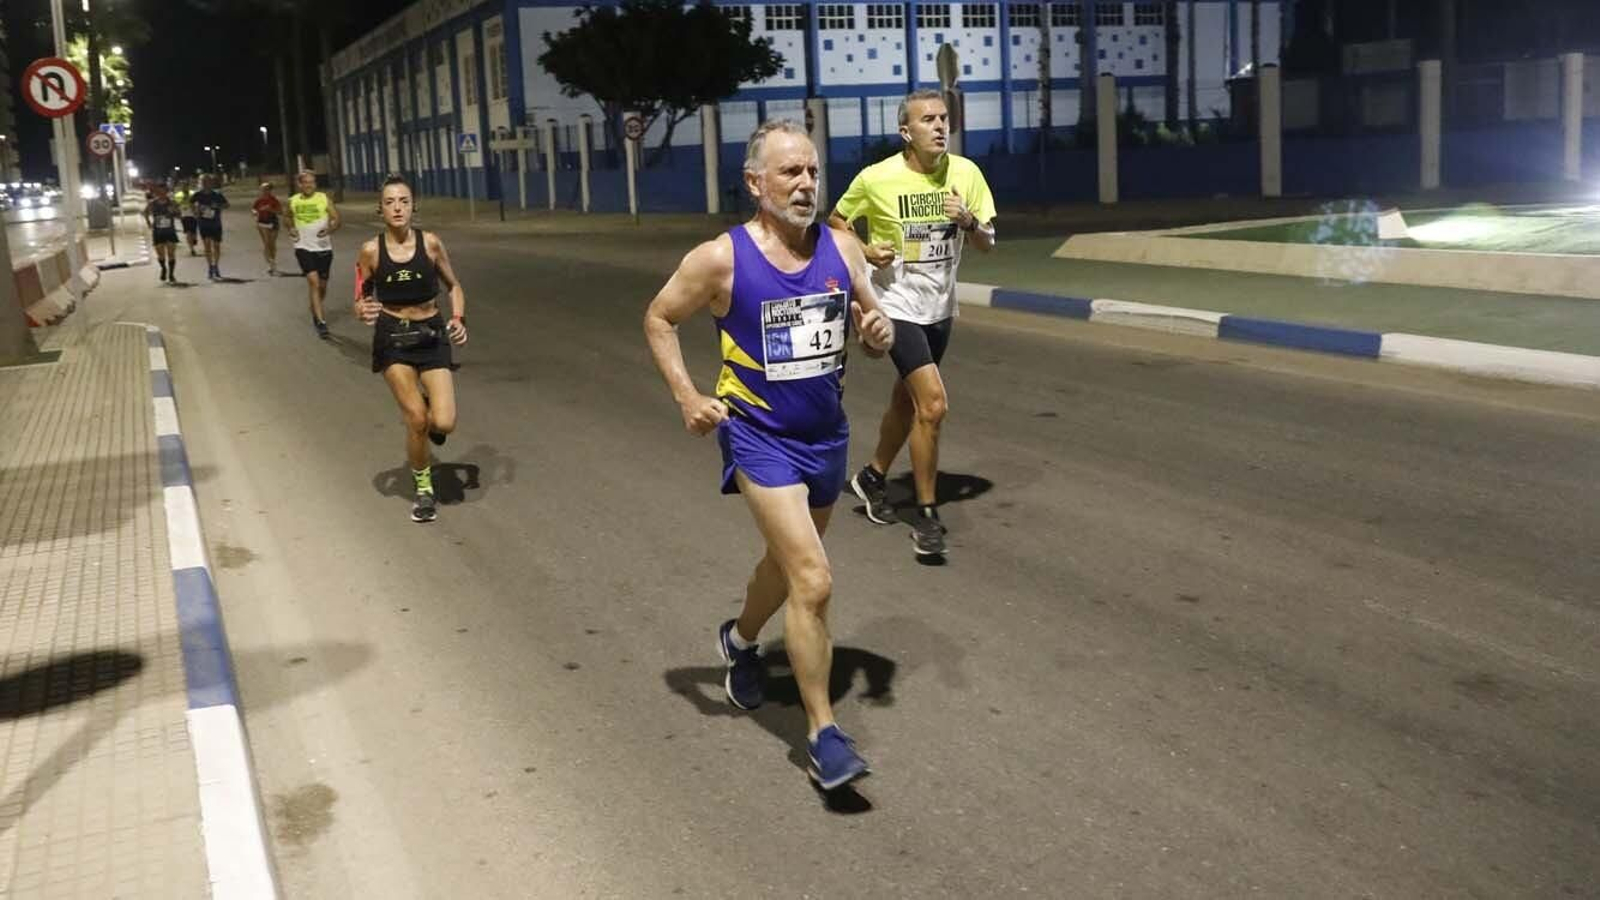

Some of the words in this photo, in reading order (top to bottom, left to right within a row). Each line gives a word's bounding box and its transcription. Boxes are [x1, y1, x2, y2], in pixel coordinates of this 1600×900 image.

[94, 139, 110, 149] 30
[910, 191, 950, 206] CIRCUIT
[898, 194, 909, 219] II
[928, 244, 948, 257] 201
[810, 329, 832, 350] 42
